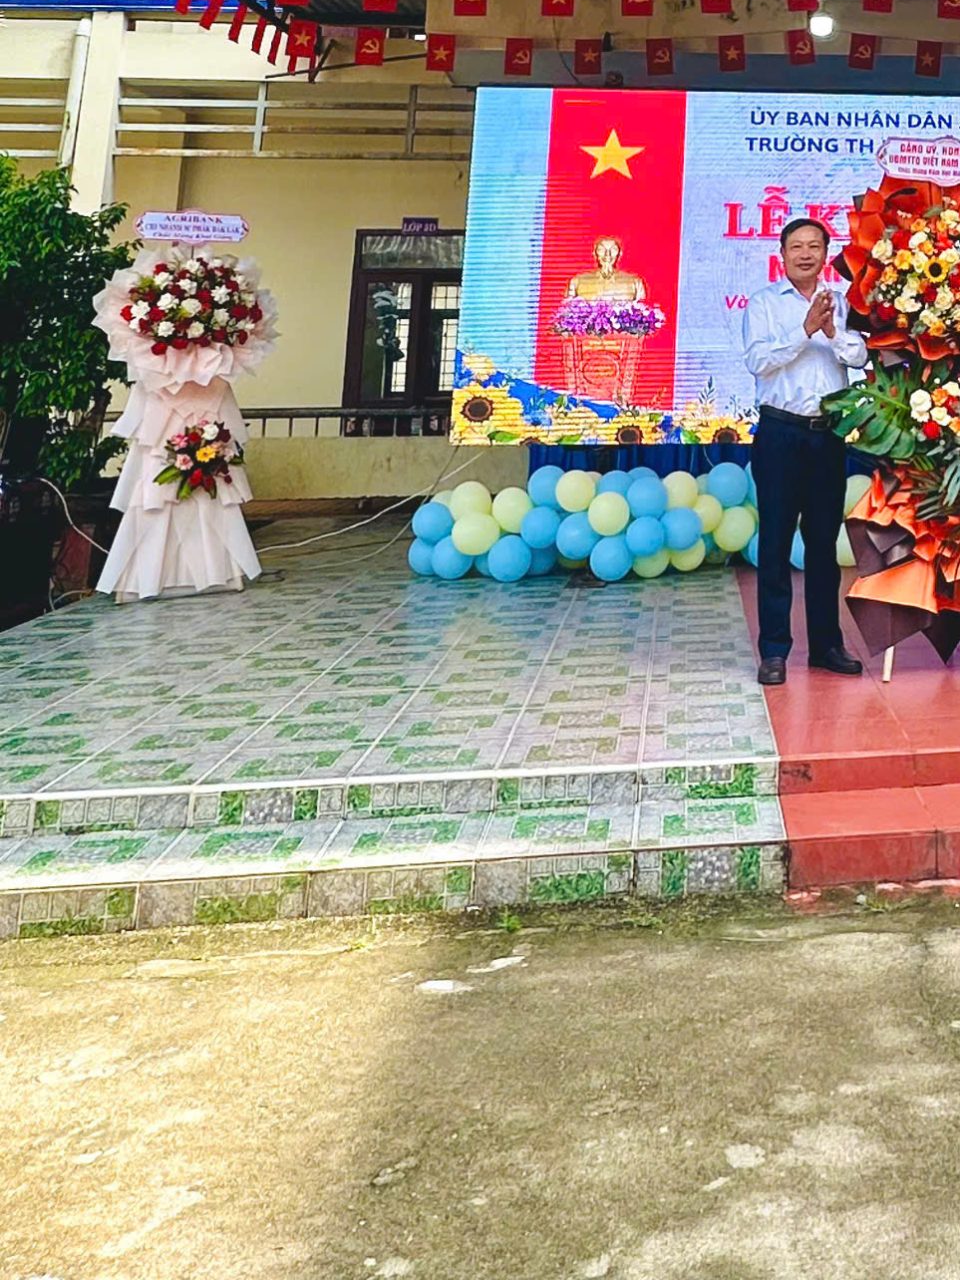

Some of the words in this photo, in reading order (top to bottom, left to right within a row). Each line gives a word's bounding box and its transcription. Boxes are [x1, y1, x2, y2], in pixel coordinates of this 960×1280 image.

[750, 106, 780, 126] ỦY
[786, 111, 829, 127] BAN
[837, 109, 900, 128] NHÂN
[907, 110, 952, 129] DÂN
[745, 132, 839, 153] TRƯỜNG
[845, 138, 874, 154] TH
[723, 185, 791, 239] LỄ
